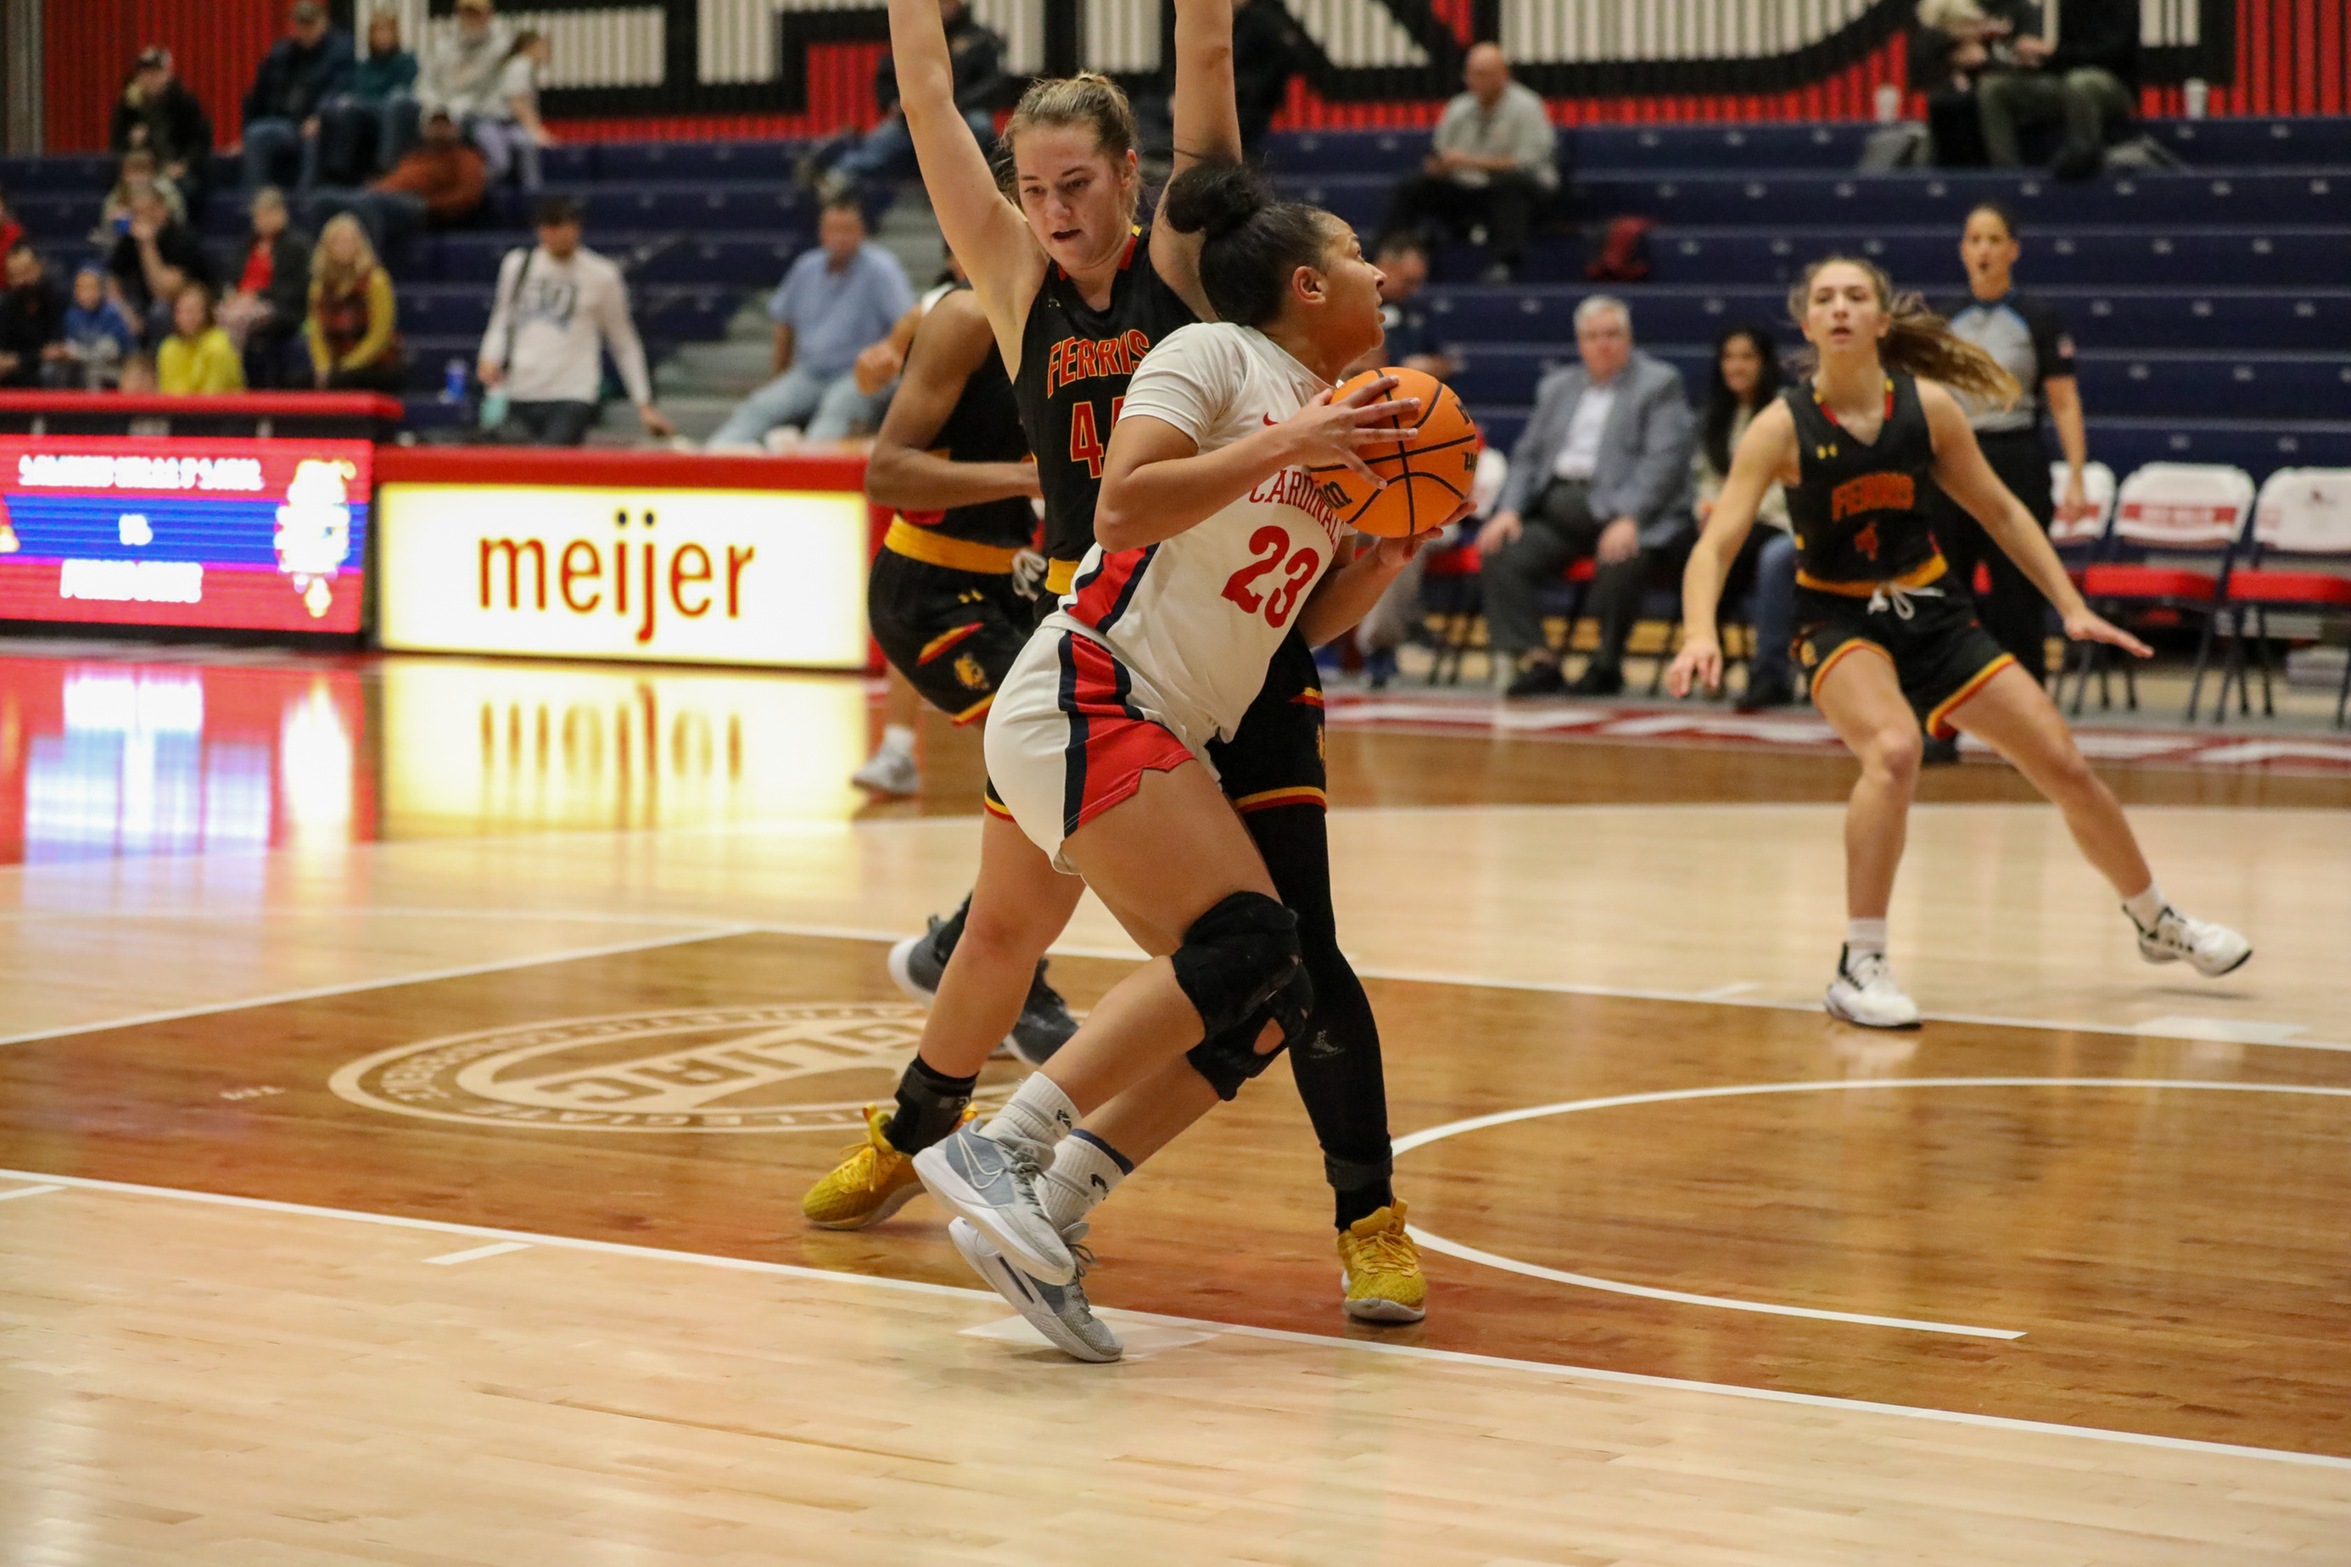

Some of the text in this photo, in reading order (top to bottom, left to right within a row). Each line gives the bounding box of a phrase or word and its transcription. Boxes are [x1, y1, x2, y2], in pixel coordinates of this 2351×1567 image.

[1047, 329, 1150, 399] FERRIS
[479, 508, 755, 643] meijer
[1221, 525, 1320, 629] 23
